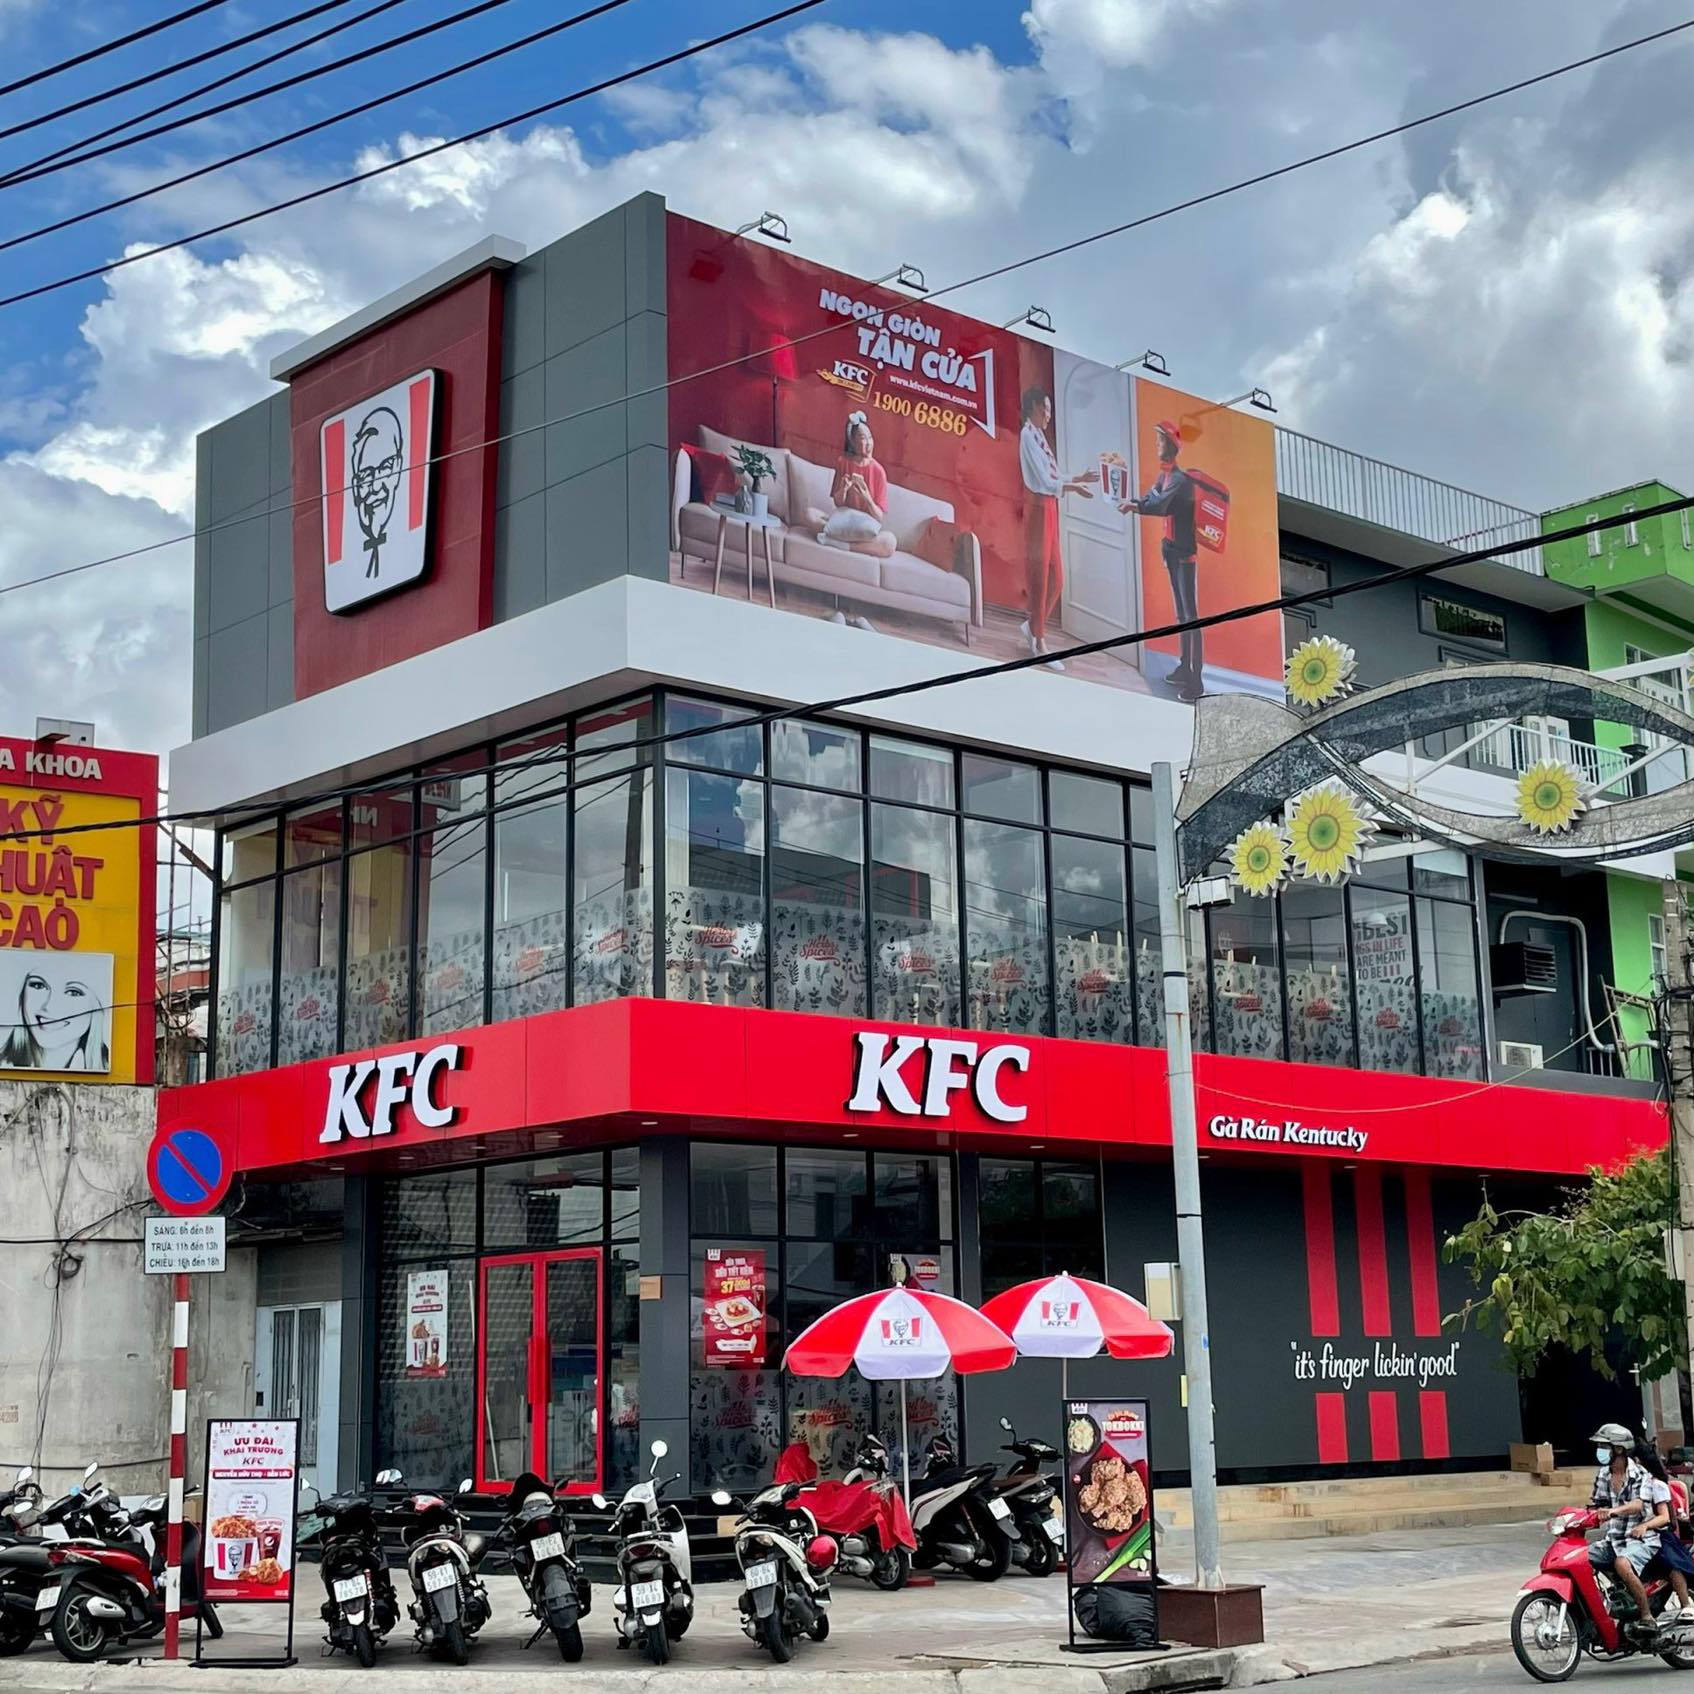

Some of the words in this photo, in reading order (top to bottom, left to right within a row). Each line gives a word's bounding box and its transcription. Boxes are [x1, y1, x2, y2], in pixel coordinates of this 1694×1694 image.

[819, 288, 884, 327] NGON
[888, 314, 941, 347] GIÒN
[833, 361, 869, 386] KFC
[857, 326, 916, 370] TẬN
[921, 348, 977, 392] CỬA
[873, 392, 911, 416] 1900
[914, 402, 967, 436] 6886
[26, 752, 102, 780] KHOA
[1357, 954, 1374, 968] ARE
[1376, 949, 1406, 964] MEANT
[1371, 966, 1382, 979] BE
[849, 1032, 1030, 1122] KFC
[319, 1044, 458, 1143] KFC
[1210, 1115, 1238, 1138] Gà
[1240, 1117, 1280, 1141] Rán
[1283, 1121, 1368, 1152] Kentucky
[889, 1338, 916, 1346] KFC
[1319, 1342, 1370, 1390] finger
[223, 1447, 245, 1456] KHAI
[242, 1457, 265, 1465] KFC
